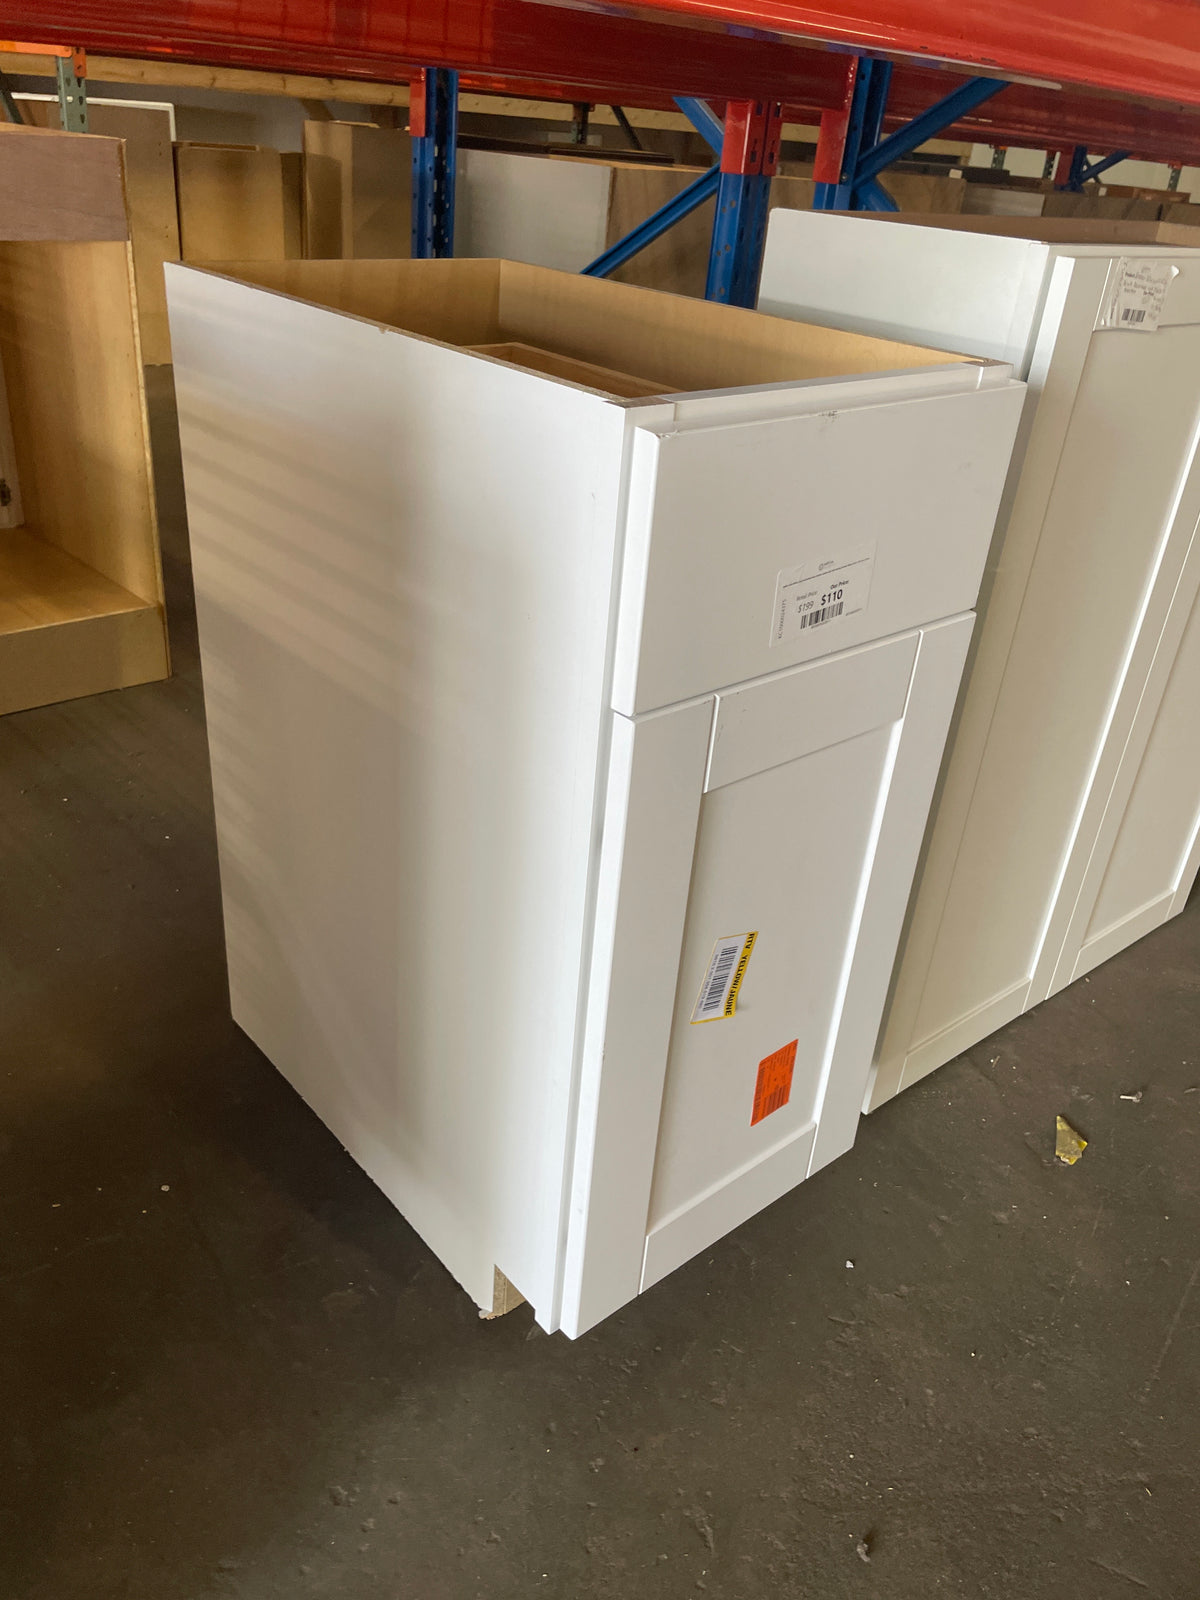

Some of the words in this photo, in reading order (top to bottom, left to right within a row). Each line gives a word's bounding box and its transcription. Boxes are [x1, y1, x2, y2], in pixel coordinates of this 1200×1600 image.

[821, 589, 843, 606] $110
[797, 600, 814, 614] $199
[745, 932, 755, 949] RTV
[725, 954, 748, 1016] YELLOW/JAUNE
